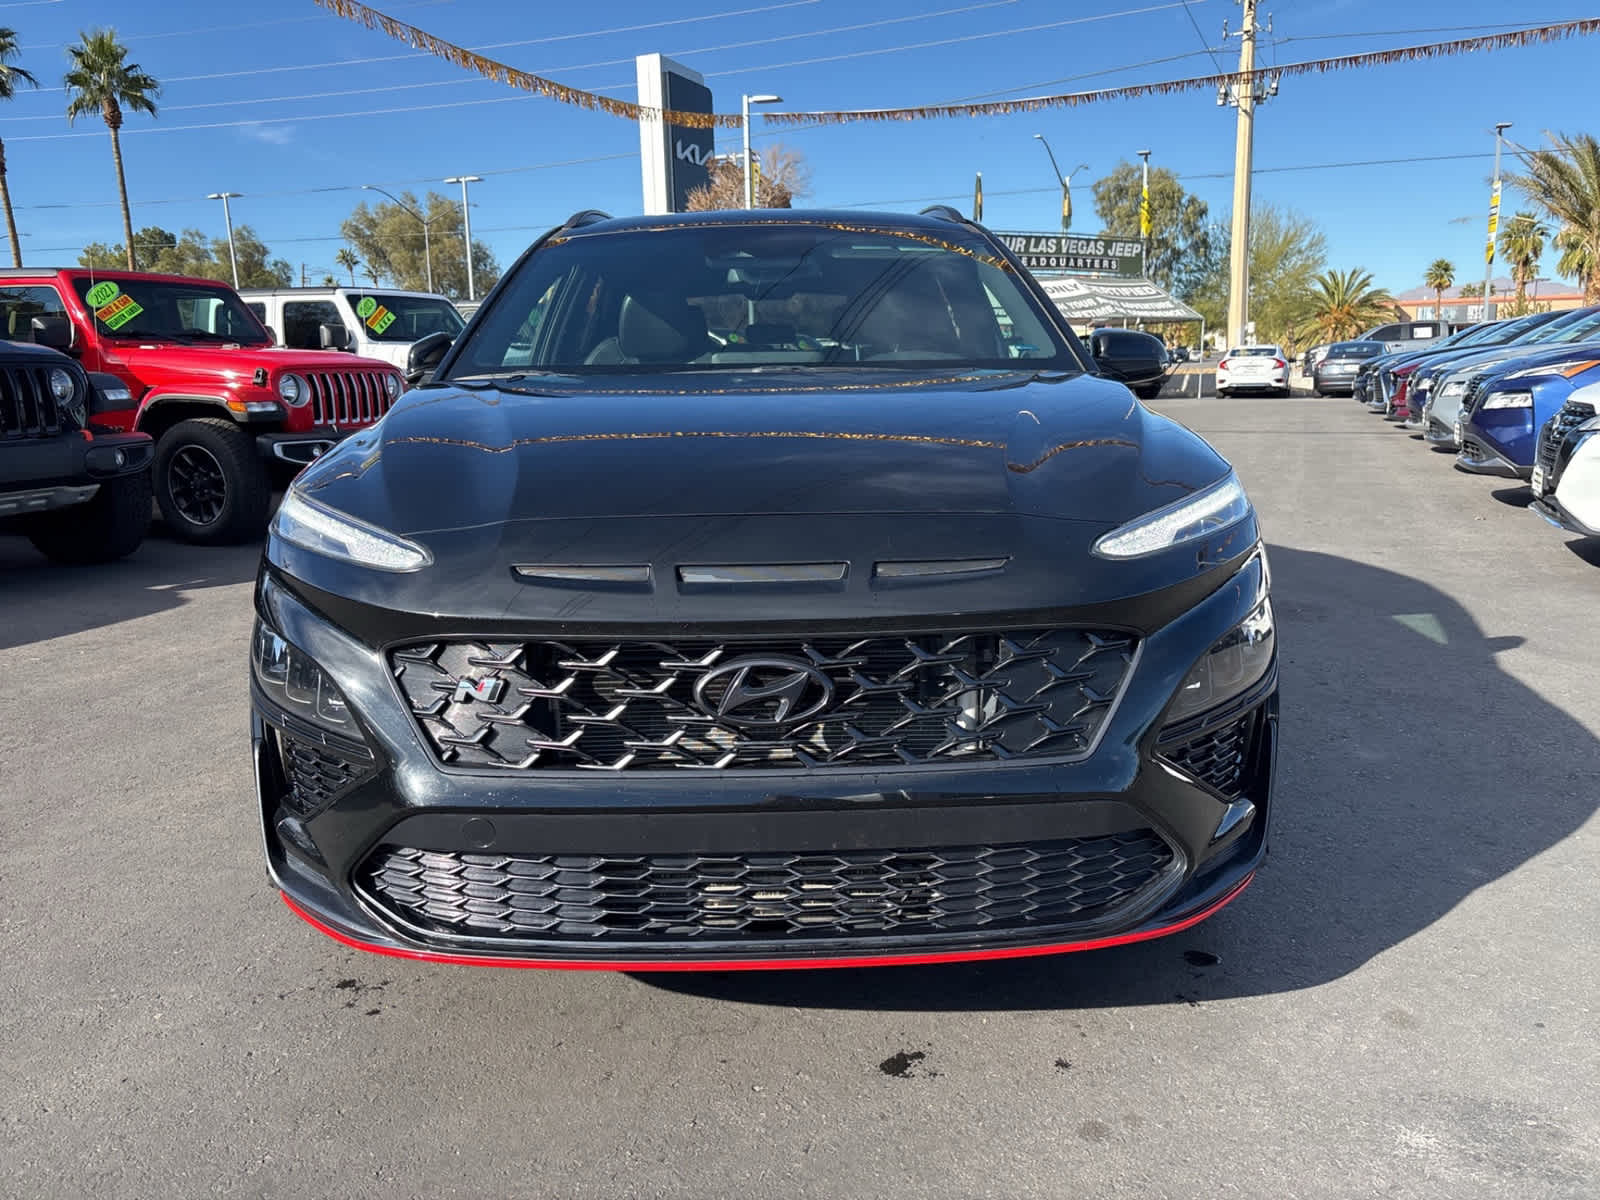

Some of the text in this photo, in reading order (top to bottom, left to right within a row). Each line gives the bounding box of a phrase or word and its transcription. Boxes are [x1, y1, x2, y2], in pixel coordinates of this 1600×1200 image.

[1028, 238, 1057, 253] LAS
[1061, 239, 1105, 255] VEGAS
[1107, 242, 1141, 257] JEEP
[95, 283, 115, 305] 2021
[1045, 283, 1080, 293] ONLY
